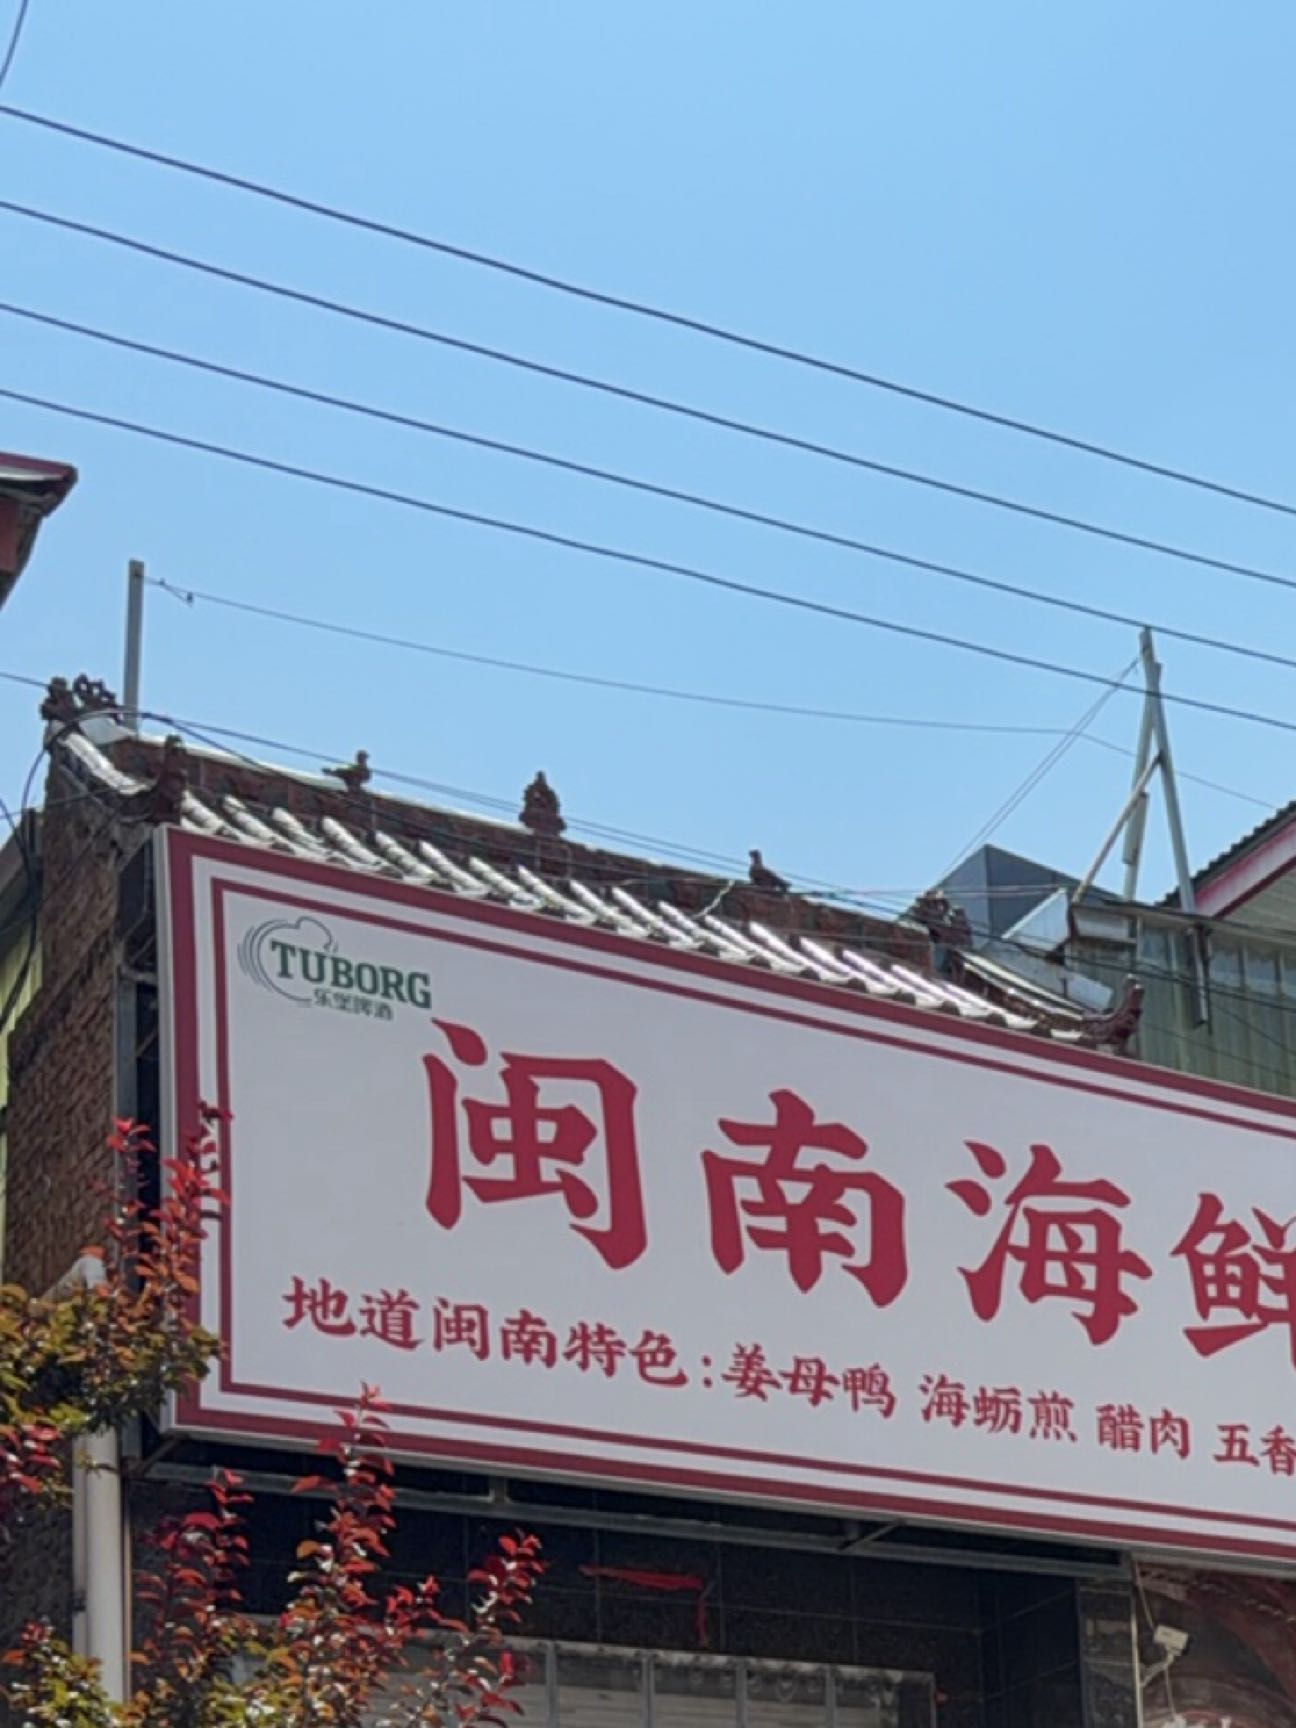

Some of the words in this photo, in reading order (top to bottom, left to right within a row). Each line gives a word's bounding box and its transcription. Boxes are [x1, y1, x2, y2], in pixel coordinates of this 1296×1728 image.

[270, 938, 433, 1010] TUBORG
[918, 1373, 1078, 1443] 海蛎煎
[1096, 1402, 1192, 1460] 醋肉
